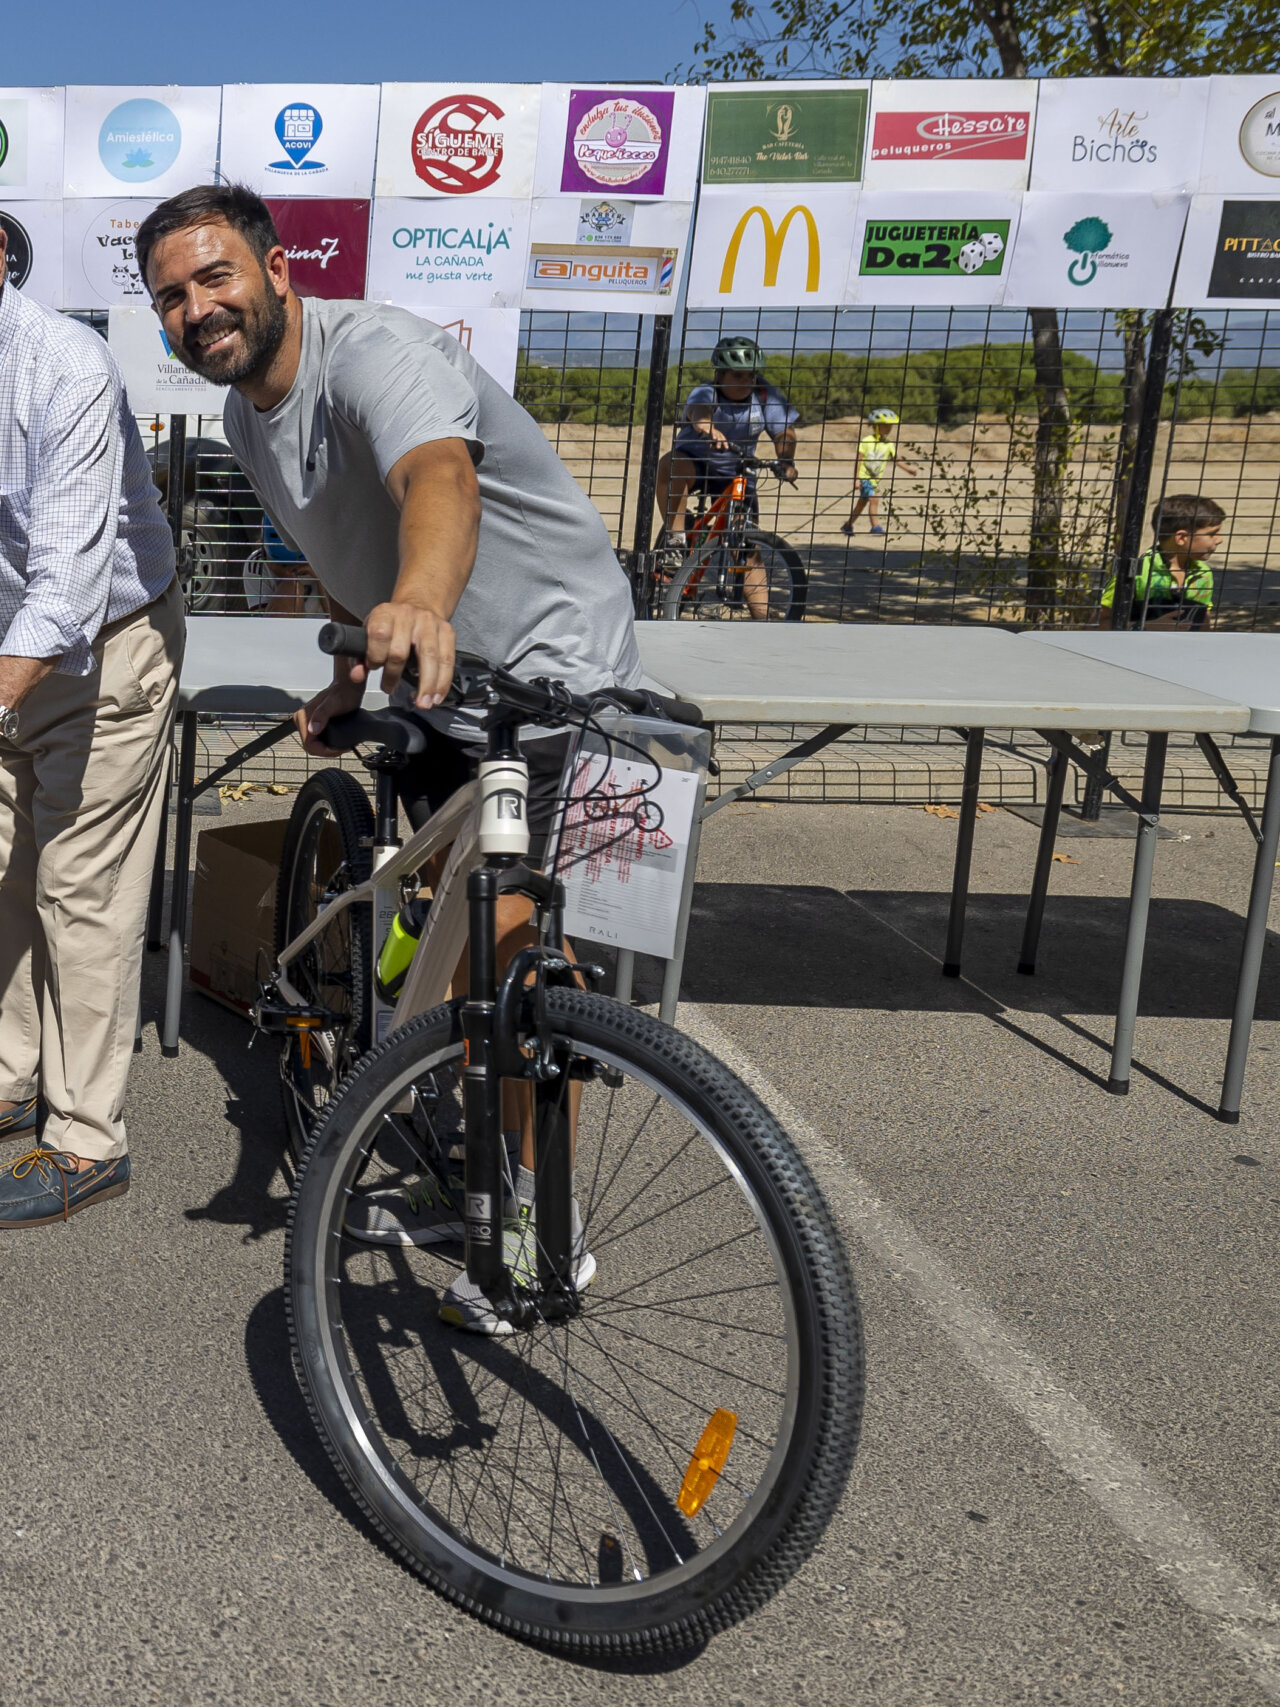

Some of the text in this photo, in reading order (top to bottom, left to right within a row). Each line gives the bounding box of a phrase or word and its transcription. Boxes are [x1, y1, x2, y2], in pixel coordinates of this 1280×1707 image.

[613, 101, 629, 112] tus
[1098, 107, 1149, 138] Arte
[106, 131, 174, 142] Amiestética
[285, 141, 311, 149] ACOVI
[872, 143, 952, 158] peluqueros
[1072, 136, 1157, 163] Bichos
[417, 148, 499, 157] CENTRO DE BAILE
[110, 219, 140, 229] Tabe
[866, 223, 980, 242] JUGUETERÍA
[416, 254, 484, 267] LA CAÑADA
[865, 243, 952, 268] Da2
[406, 271, 493, 283] me gusta verte
[538, 261, 649, 281] anguita
[608, 278, 647, 286] PELUQUEROS
[169, 374, 207, 385] Cañada
[502, 797, 518, 815] R
[589, 926, 618, 939] RALI
